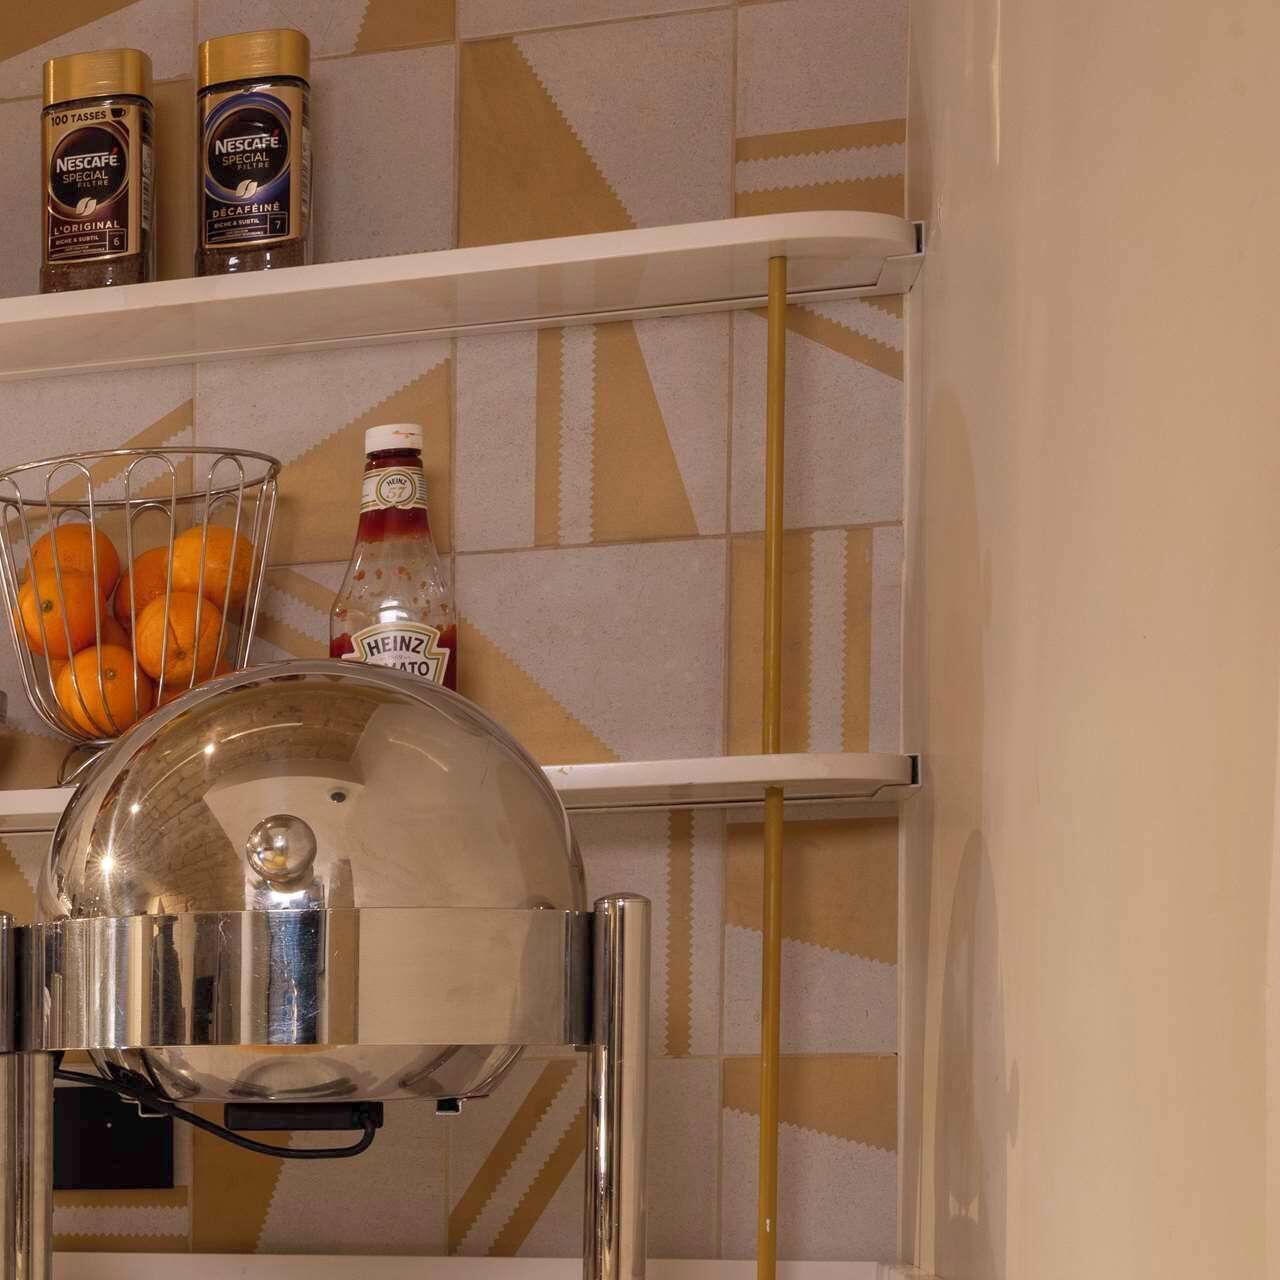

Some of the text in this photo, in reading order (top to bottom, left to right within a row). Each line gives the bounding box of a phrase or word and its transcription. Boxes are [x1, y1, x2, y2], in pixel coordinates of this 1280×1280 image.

[51, 110, 107, 127] 100 TASSES
[215, 128, 280, 155] NESCAFÉ
[56, 147, 119, 174] NESCAFÉ
[222, 152, 270, 166] SPECIAL
[237, 162, 270, 170] FILTRE
[62, 170, 109, 184] SPECIAL
[77, 179, 109, 188] FILTRE
[212, 201, 281, 218] DÉCAFÉINÉ
[54, 220, 121, 236] L'ORIGINAL
[112, 237, 121, 247] 6
[386, 477, 408, 486] HEINZ
[366, 635, 426, 658] HEINZ
[367, 660, 430, 677] ATO
